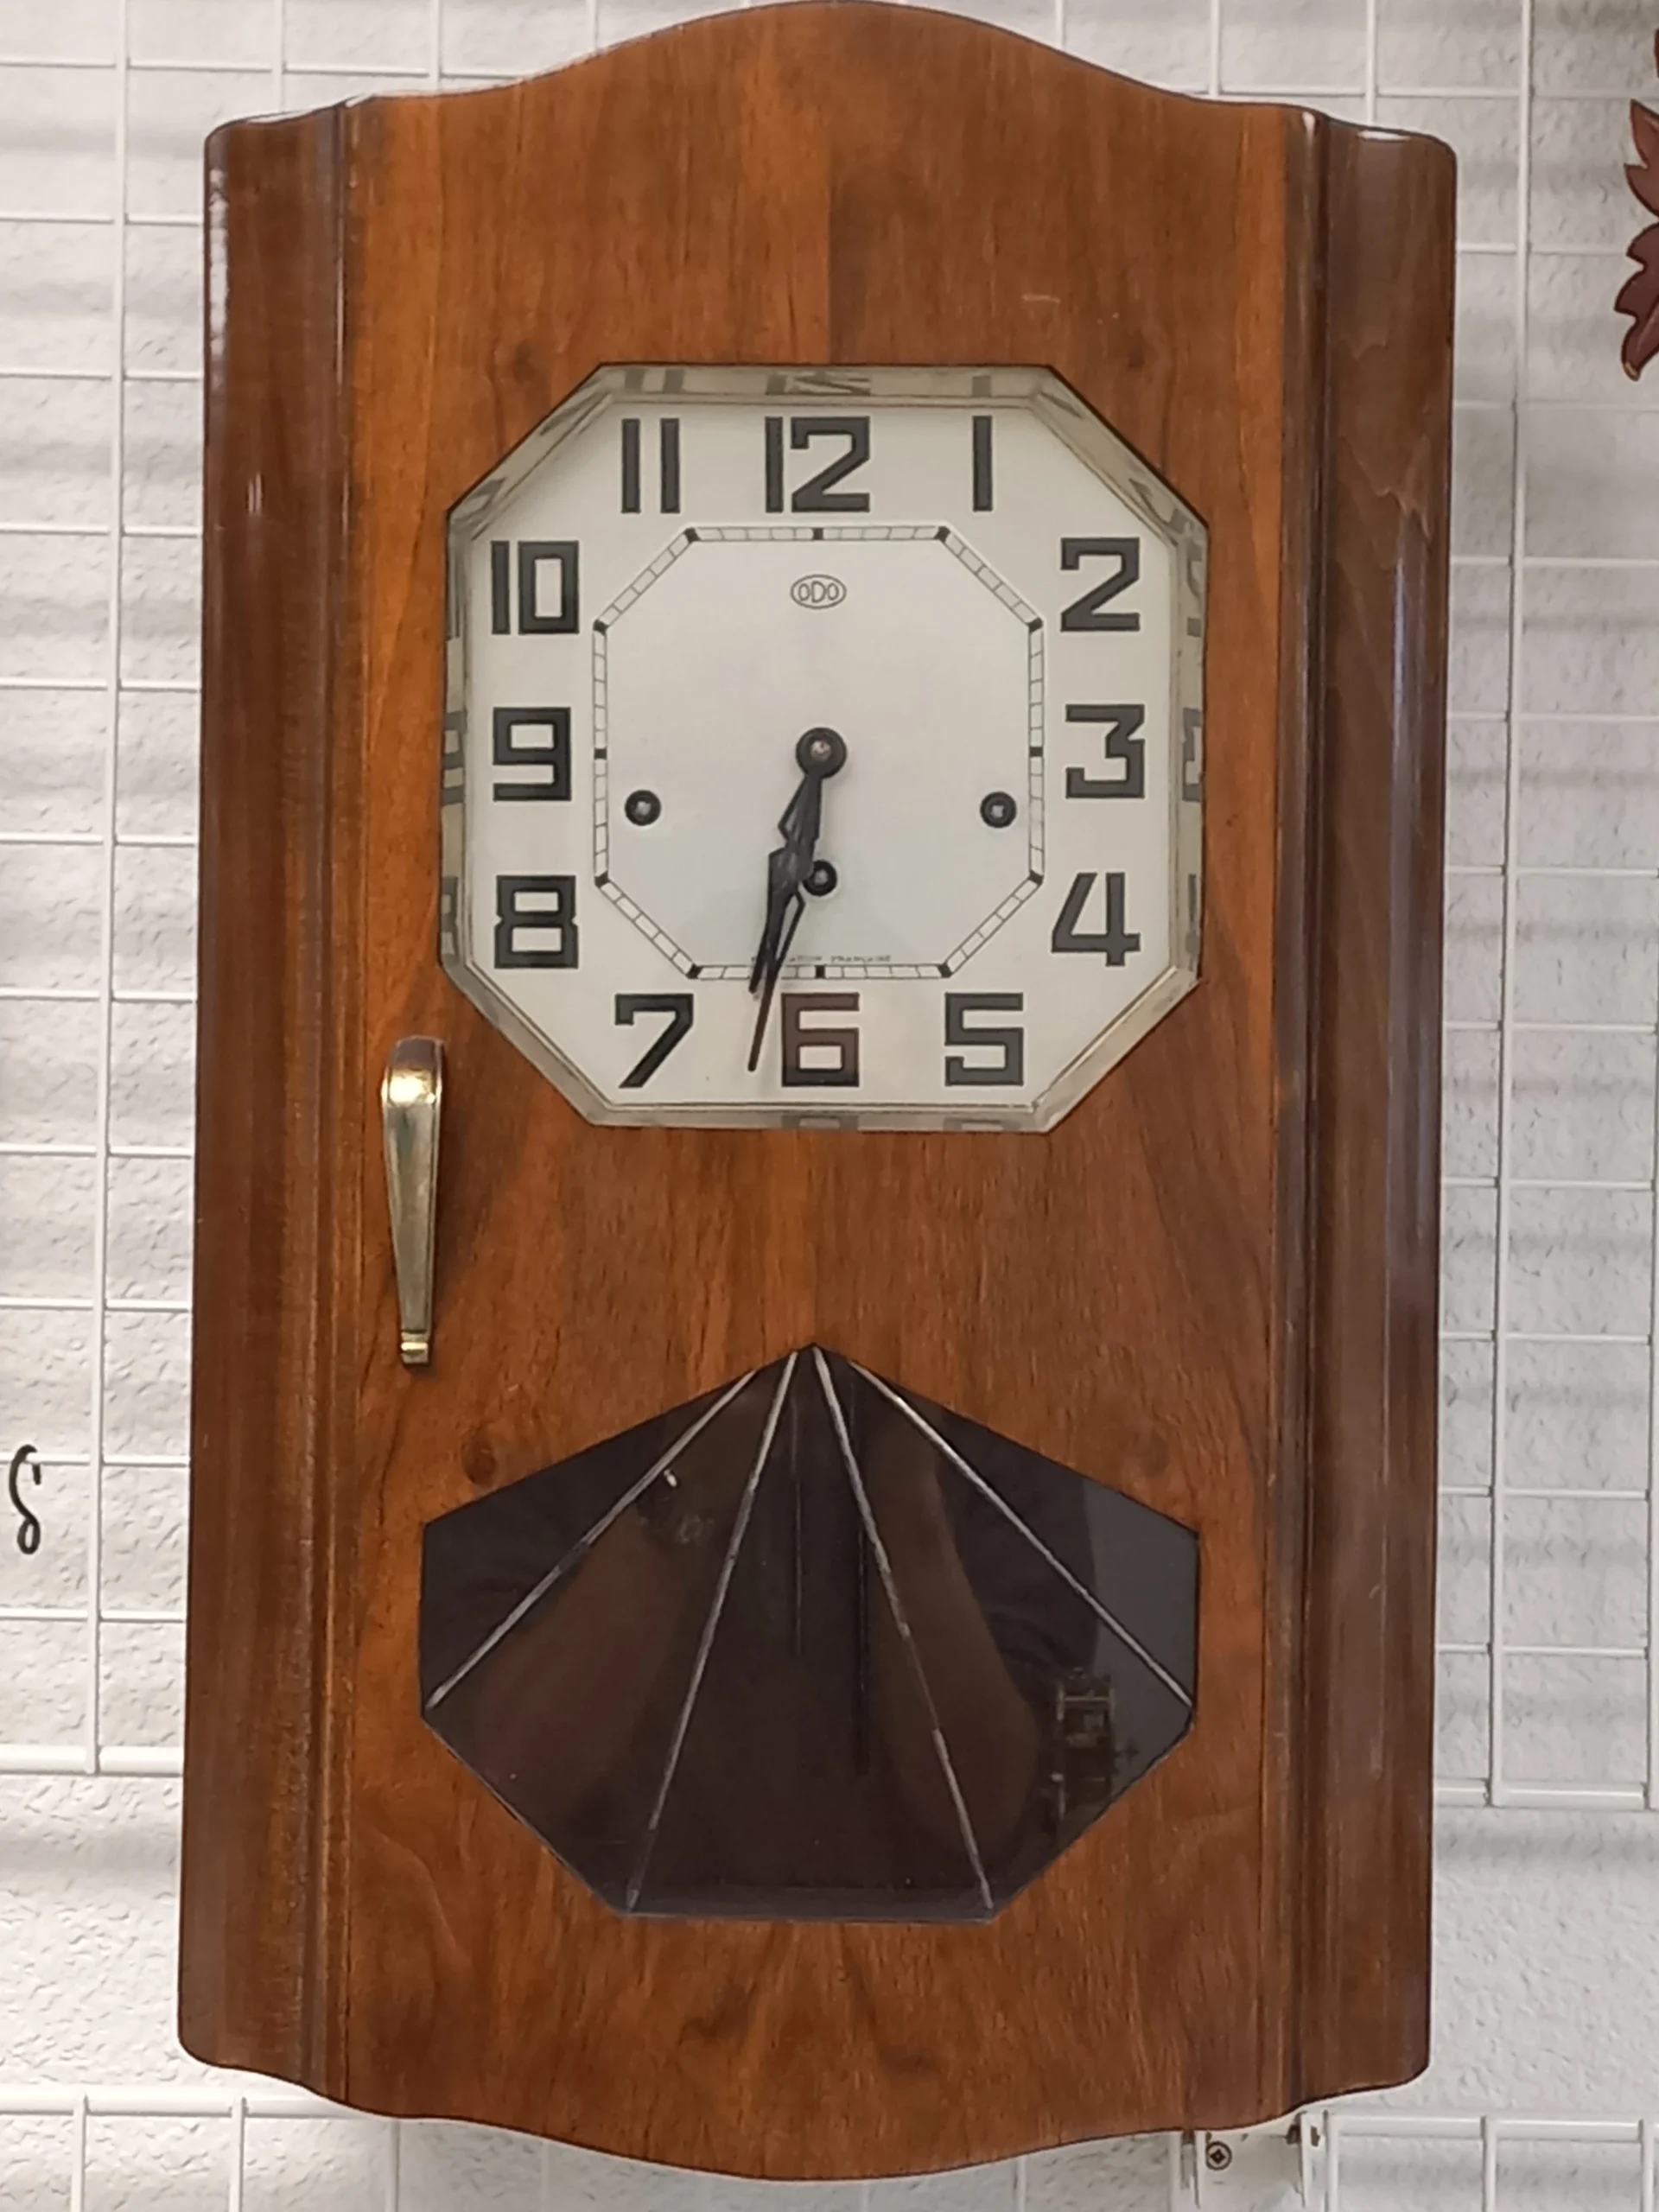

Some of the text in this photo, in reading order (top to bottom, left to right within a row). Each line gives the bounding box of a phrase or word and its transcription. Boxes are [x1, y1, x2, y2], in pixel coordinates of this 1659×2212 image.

[622, 417, 679, 514] 11
[765, 416, 870, 513] 12
[973, 416, 993, 512] 1
[491, 540, 580, 635] 10
[796, 578, 842, 605] ODO
[1061, 537, 1141, 632] 2
[493, 707, 572, 802] 9
[1066, 704, 1145, 799] 3
[494, 875, 579, 969] 8
[1052, 873, 1141, 967] 4
[614, 993, 694, 1089] 7
[781, 993, 860, 1088] 6
[944, 993, 1024, 1087] 5
